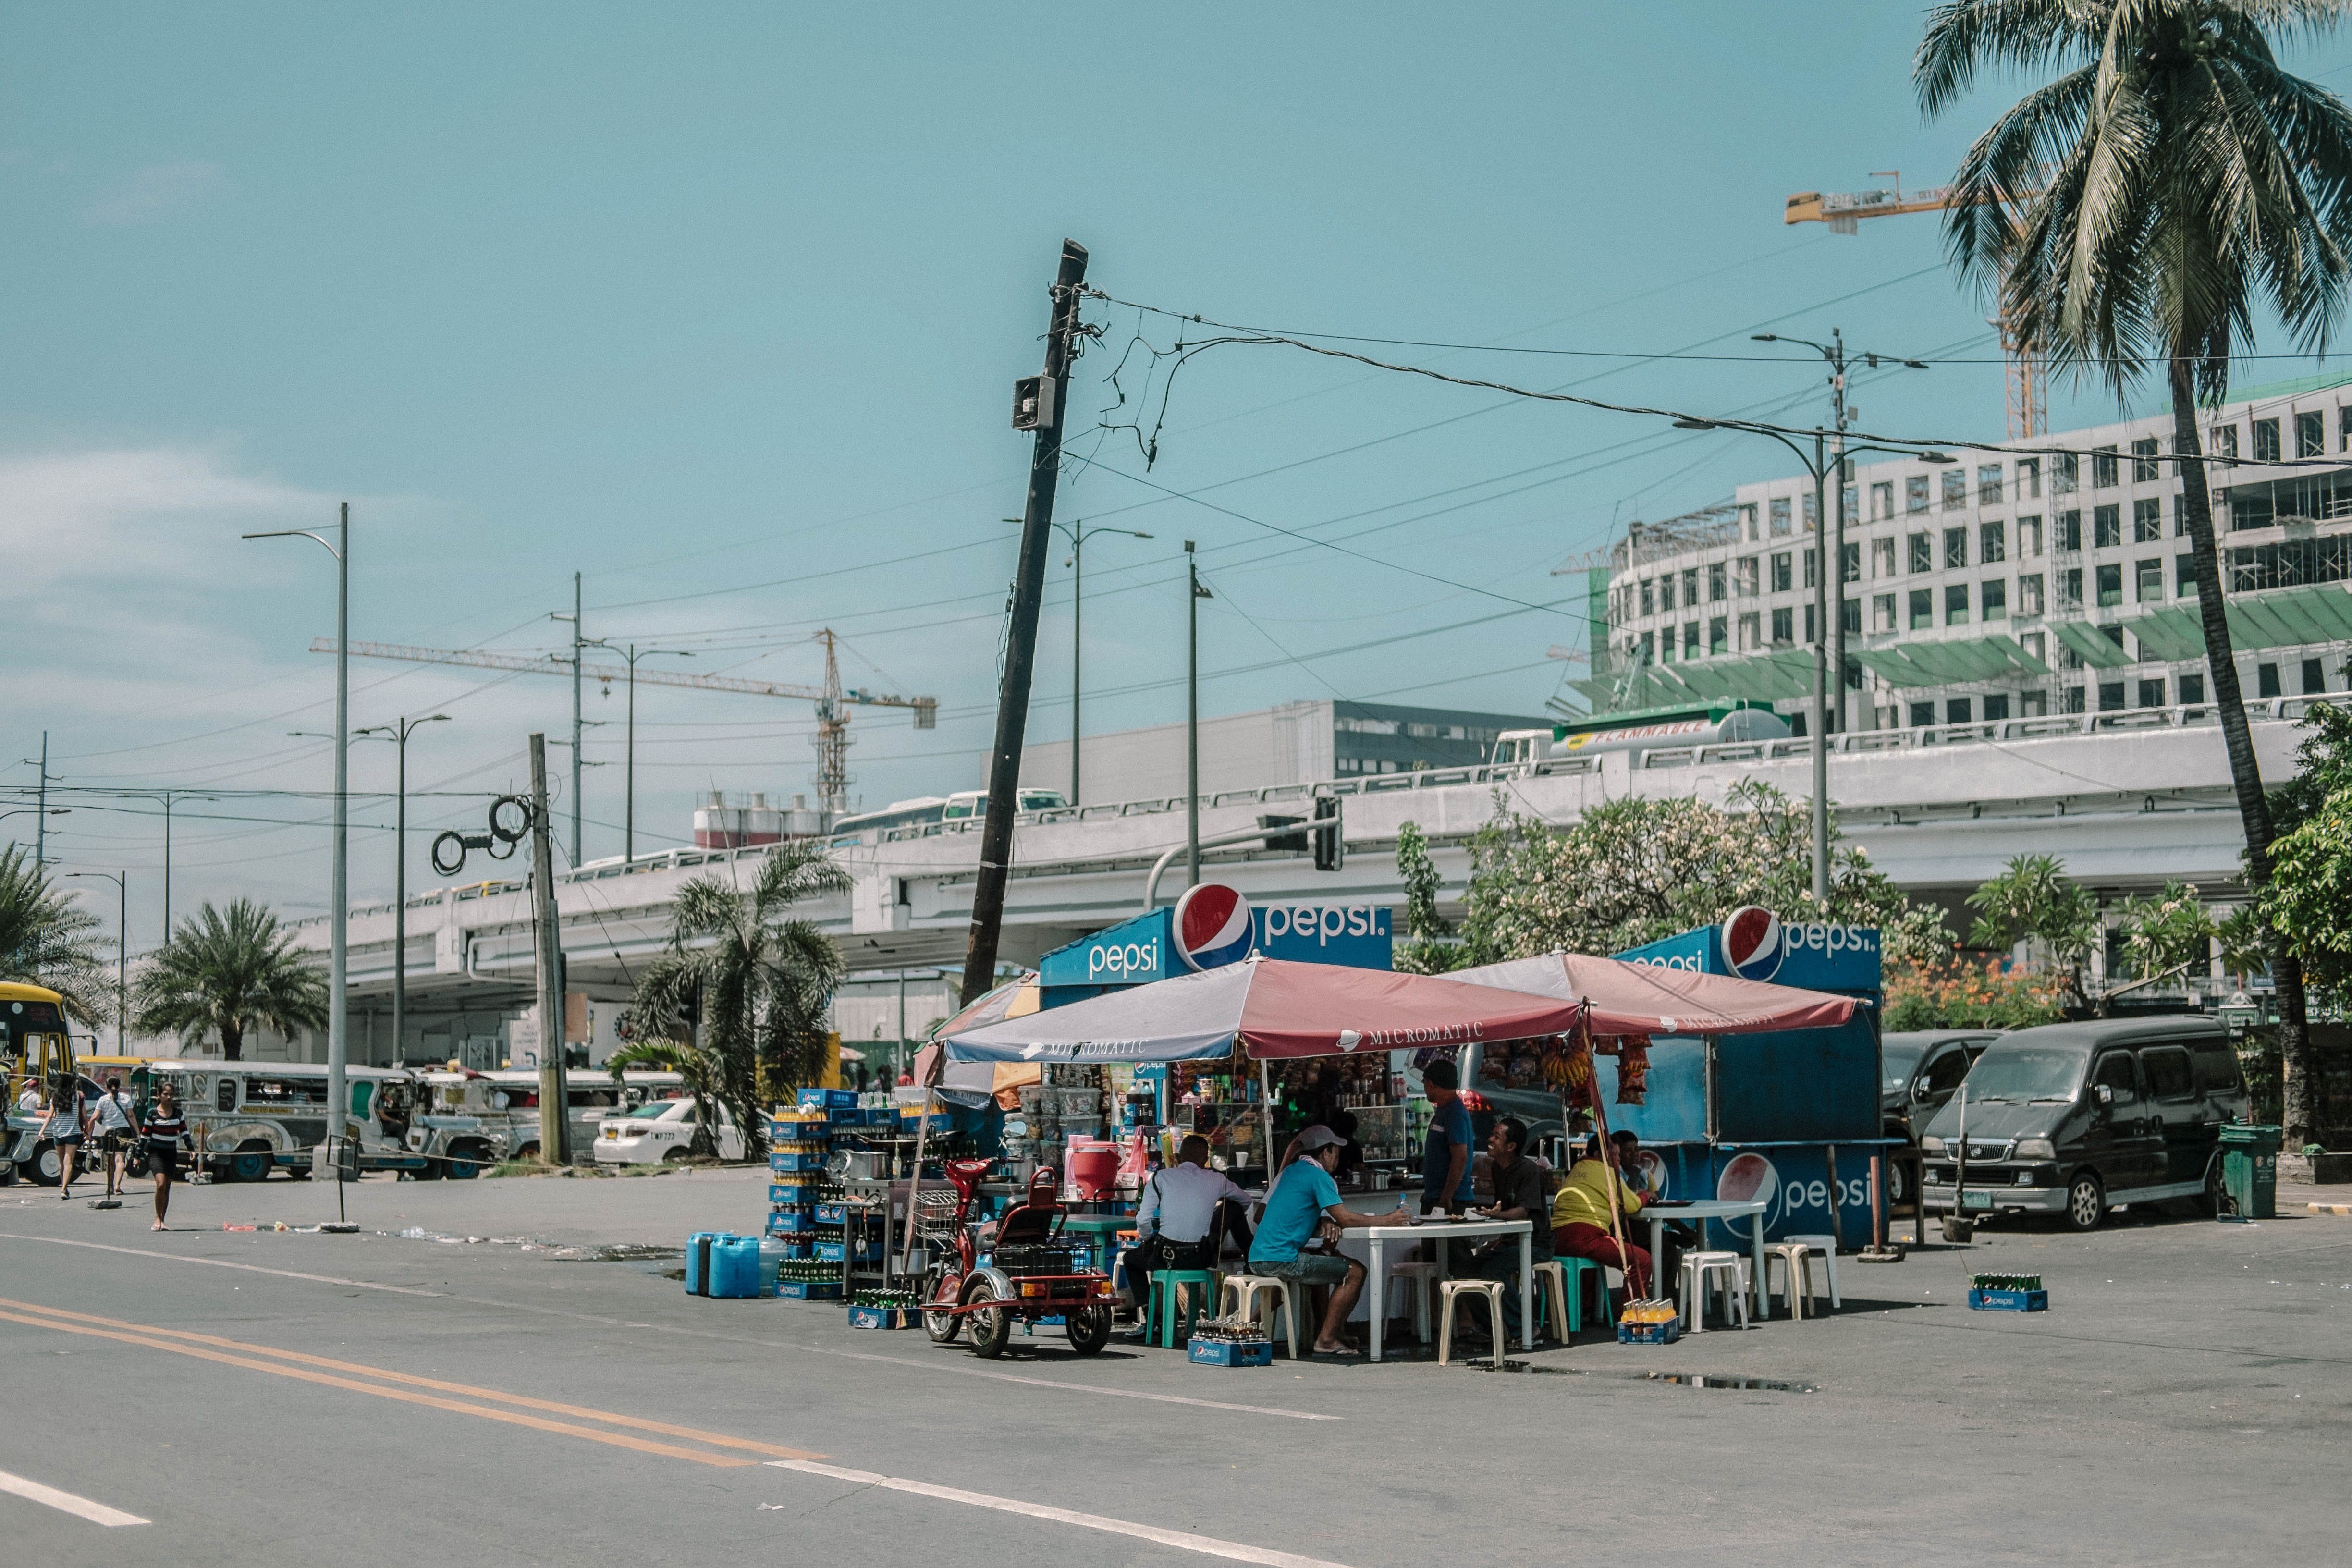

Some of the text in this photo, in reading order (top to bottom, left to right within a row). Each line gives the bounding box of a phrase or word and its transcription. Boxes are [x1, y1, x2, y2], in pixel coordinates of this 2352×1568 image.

[1595, 721, 1703, 743] FLAMMABLE
[1089, 937, 1157, 980] pepsi
[1368, 1021, 1484, 1045] MICROMATIC
[1786, 1172, 1871, 1217] pepsi
[823, 1248, 839, 1256] pepsi
[784, 1286, 800, 1295] pepsi
[1993, 1298, 2014, 1306] pepsi
[1204, 1349, 1220, 1357] pepsi
